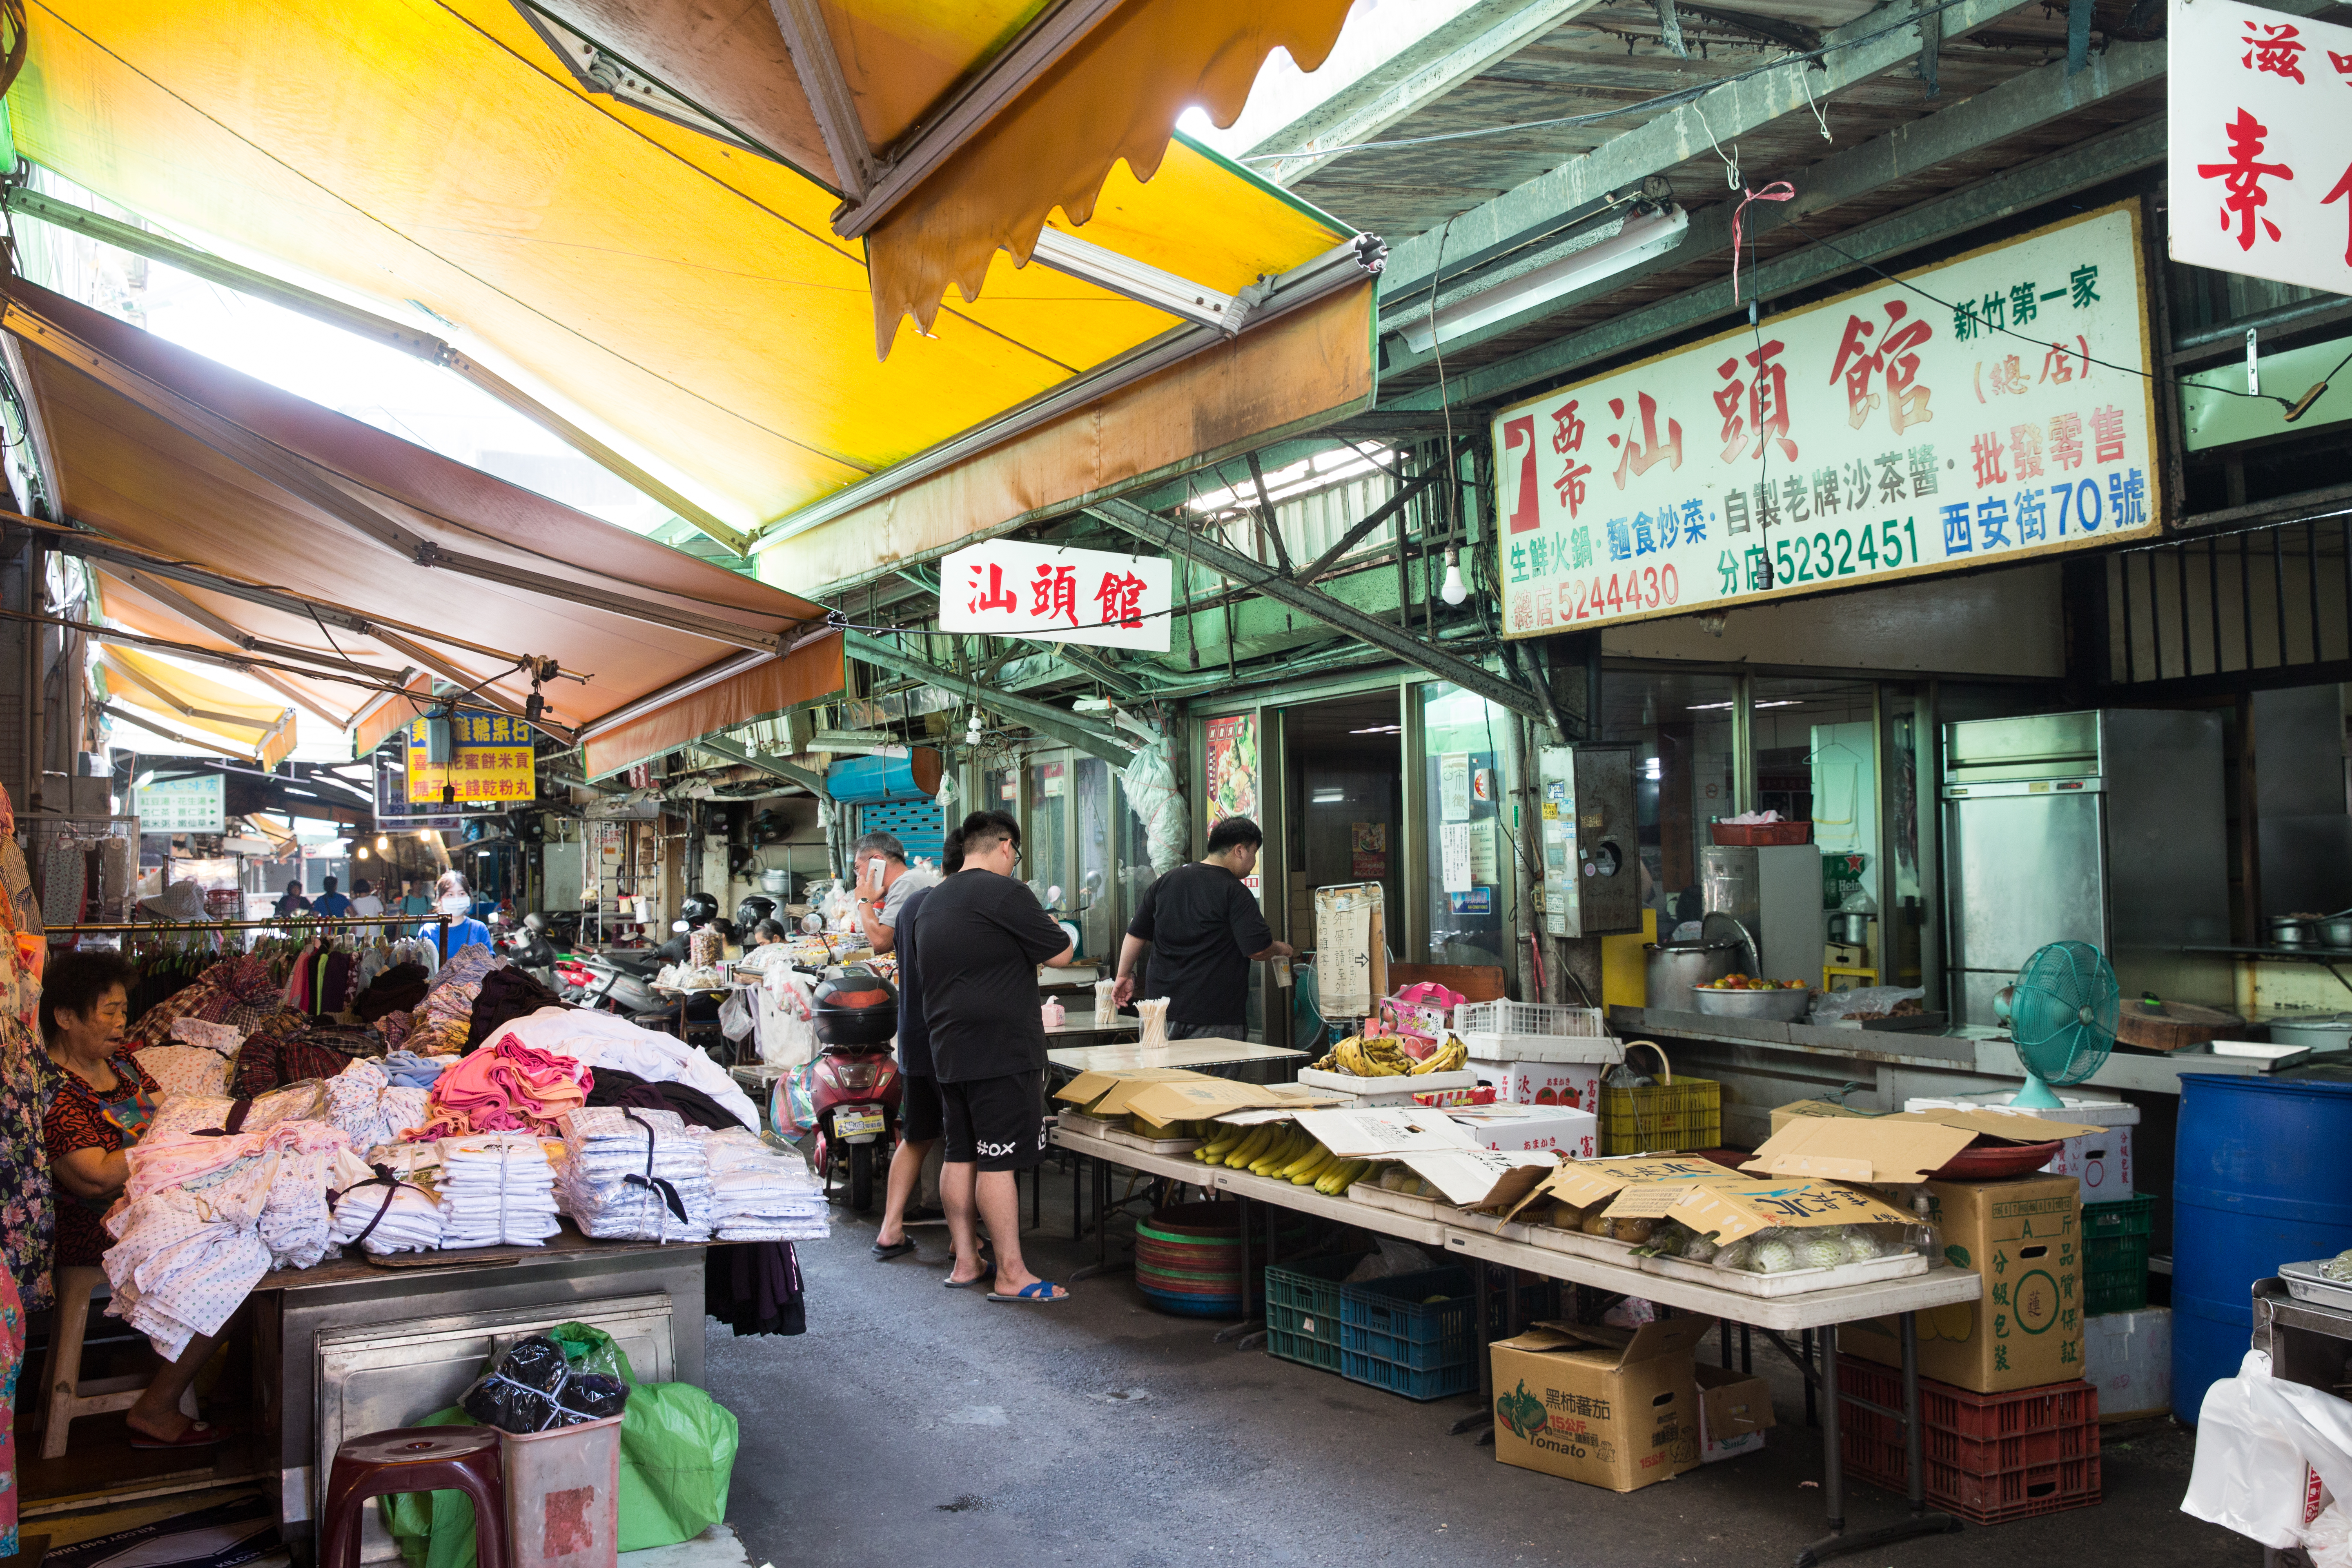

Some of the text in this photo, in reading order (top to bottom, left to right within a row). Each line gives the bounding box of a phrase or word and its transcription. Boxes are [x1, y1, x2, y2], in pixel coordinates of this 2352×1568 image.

[2241, 20, 2352, 87] 滋
[1953, 265, 2101, 342] 新竹第一家
[1608, 300, 1933, 489] 汕頭館
[1939, 468, 2146, 557] 西安街70號
[967, 563, 1148, 630] 汕頭館
[1546, 1077, 1570, 1086] あまかき
[1524, 1136, 1556, 1150] あまかき
[2022, 1219, 2034, 1239] A
[1992, 1249, 2011, 1372] 分級包裝
[1546, 1388, 1610, 1420] 黑柿蕃茄
[1549, 1414, 1587, 1435] 15公斤
[1528, 1430, 1587, 1458] Tomato
